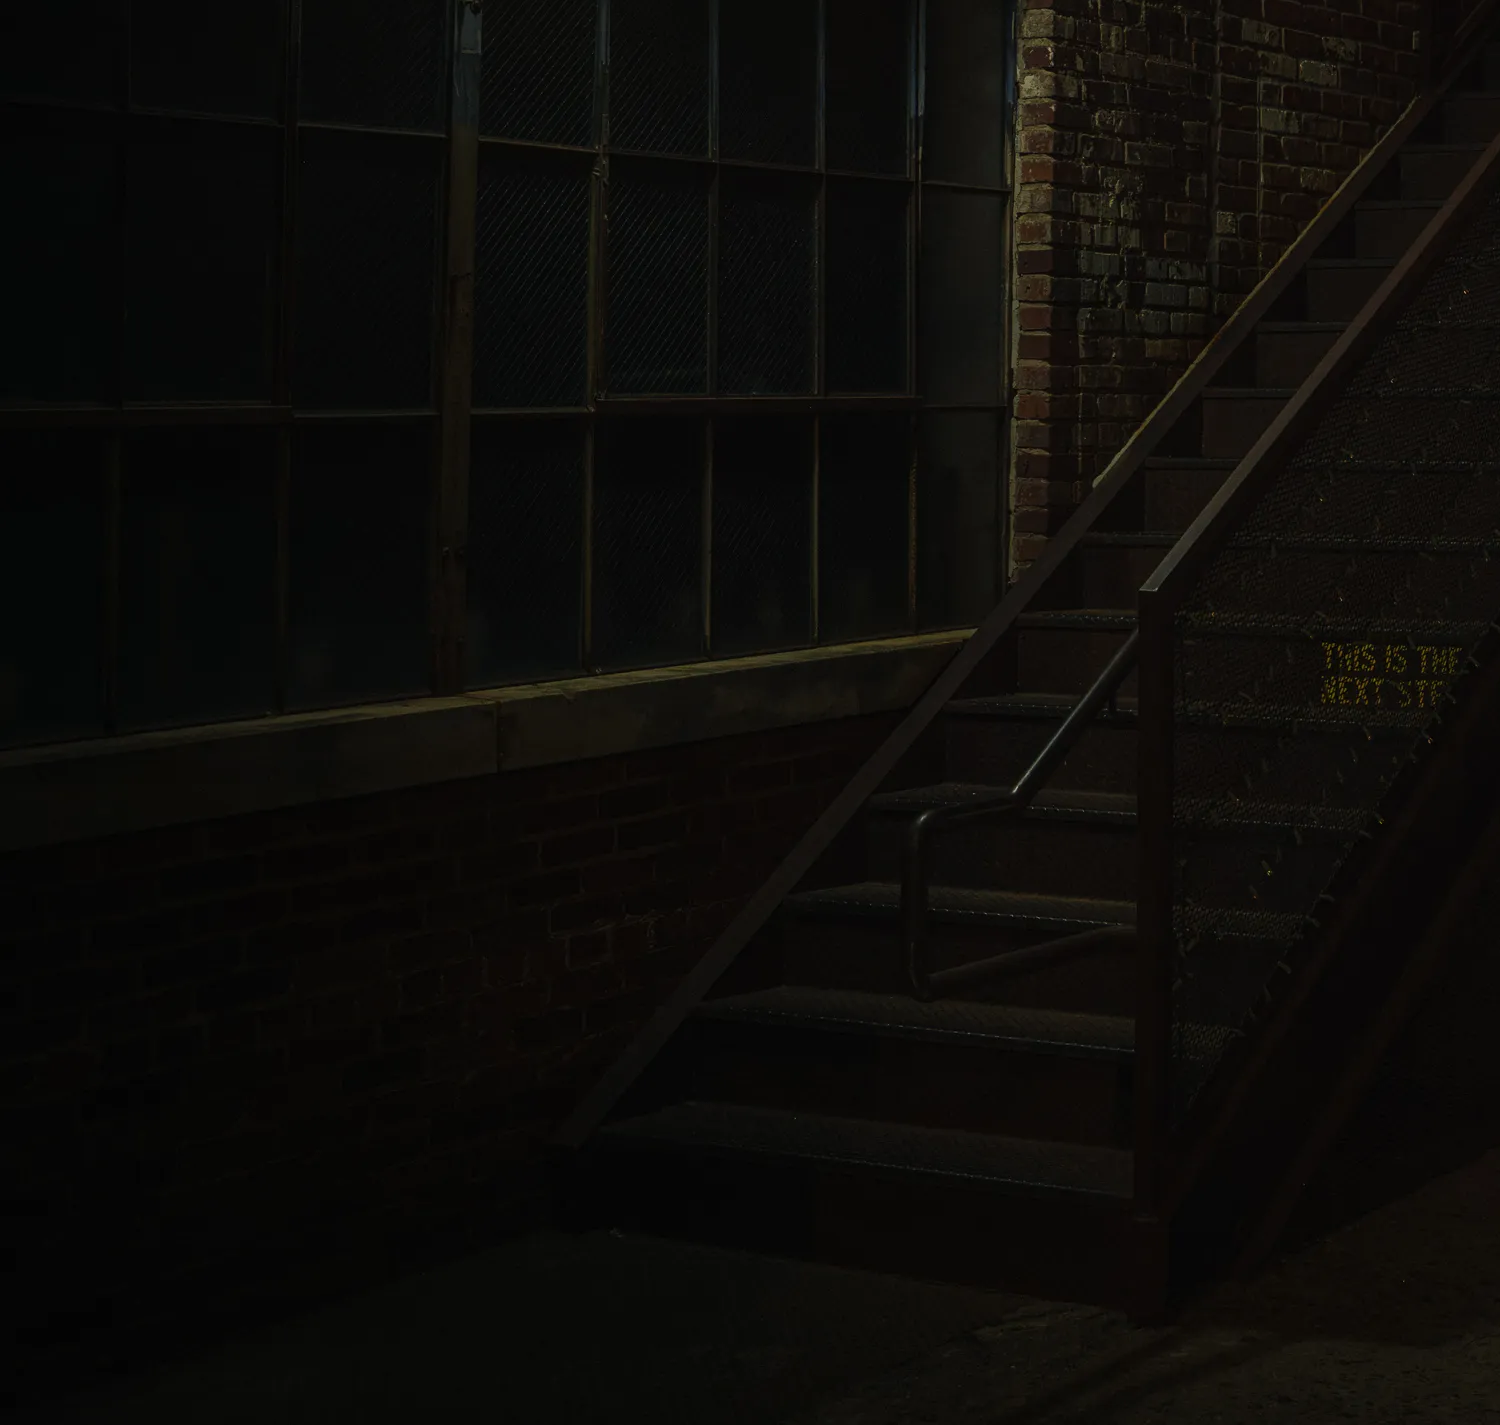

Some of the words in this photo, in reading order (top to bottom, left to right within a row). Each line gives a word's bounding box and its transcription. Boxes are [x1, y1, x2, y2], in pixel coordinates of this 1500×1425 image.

[1321, 641, 1377, 673] THIS
[1384, 644, 1408, 674] IS
[1416, 644, 1462, 675] THE
[1321, 675, 1385, 706] NEXT
[1397, 679, 1449, 708] STE
